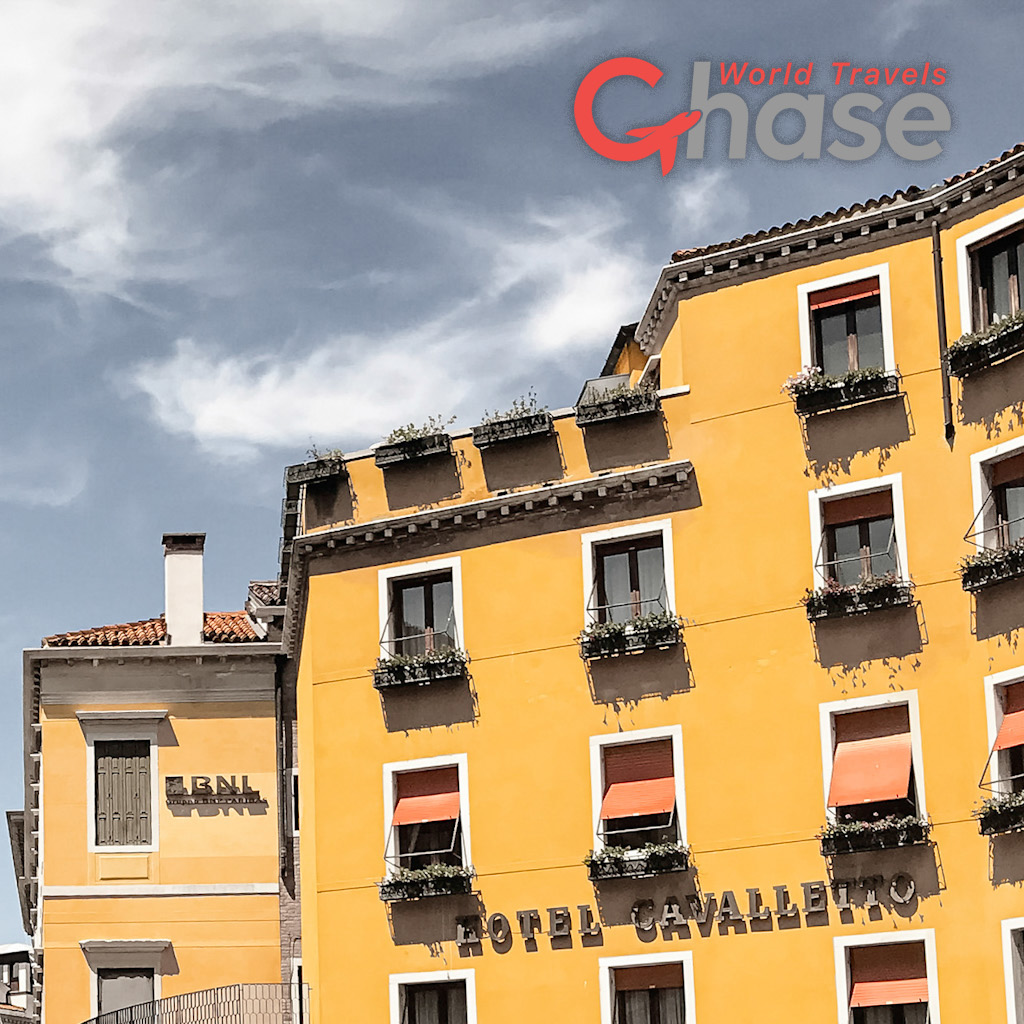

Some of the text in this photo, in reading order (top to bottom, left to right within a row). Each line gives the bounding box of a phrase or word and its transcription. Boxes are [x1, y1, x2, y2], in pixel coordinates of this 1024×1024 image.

[191, 775, 260, 796] BNL
[456, 872, 916, 946] HOTEL CAVALLETTO
